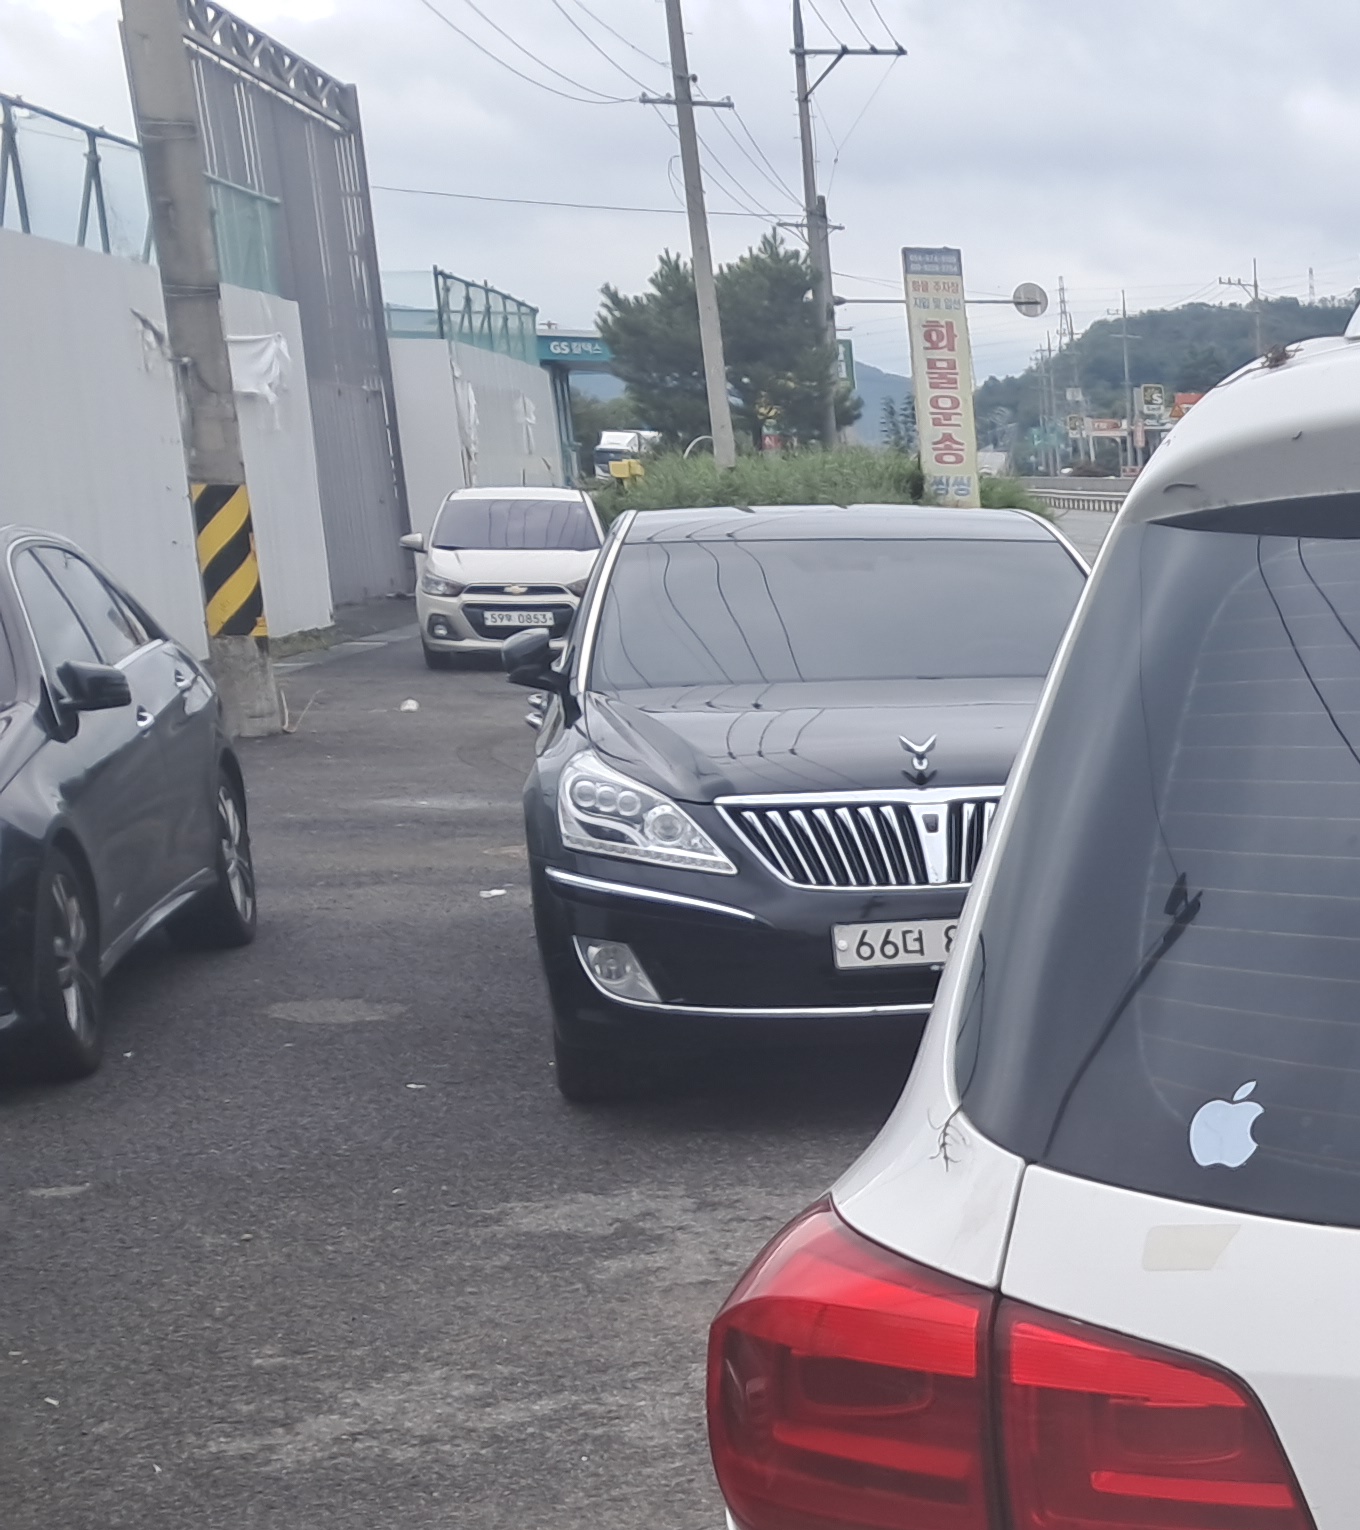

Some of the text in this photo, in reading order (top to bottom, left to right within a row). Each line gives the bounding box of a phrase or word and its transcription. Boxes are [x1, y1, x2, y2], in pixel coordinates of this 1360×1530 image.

[932, 281, 959, 294] 주차장
[550, 341, 570, 354] GS
[921, 320, 966, 465] 화물운송
[517, 613, 548, 624] 0853
[855, 928, 925, 961] 66더
